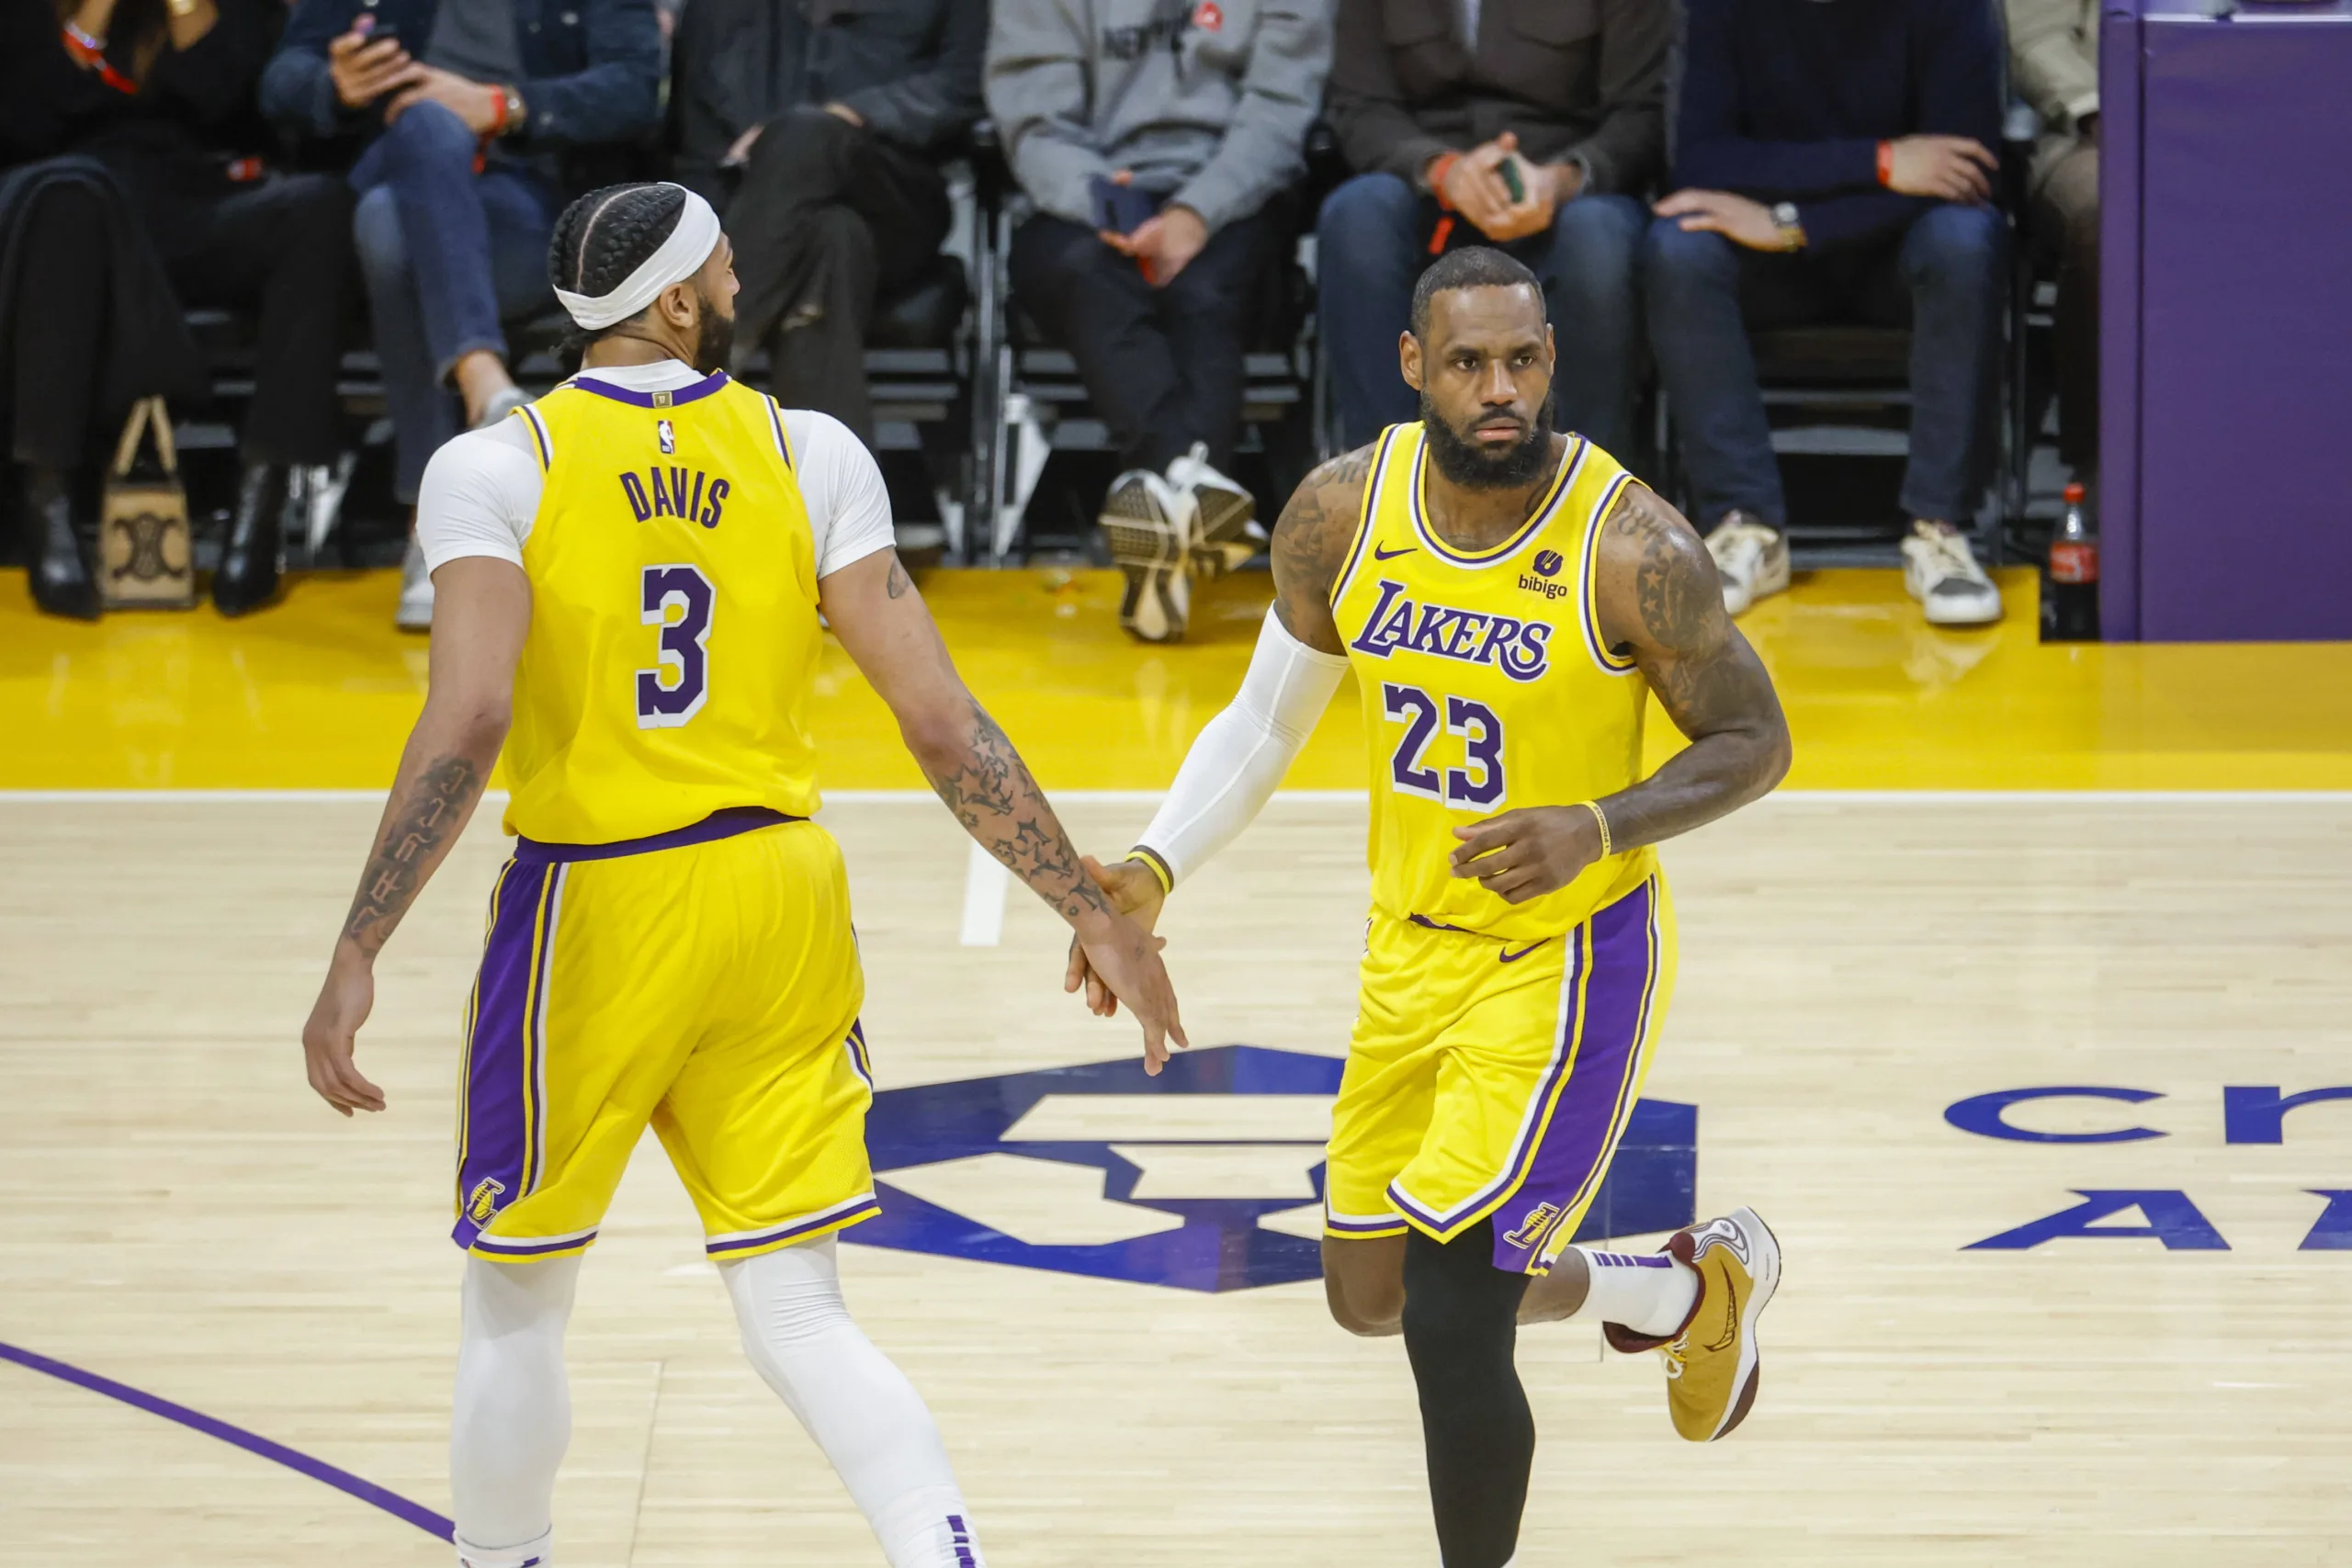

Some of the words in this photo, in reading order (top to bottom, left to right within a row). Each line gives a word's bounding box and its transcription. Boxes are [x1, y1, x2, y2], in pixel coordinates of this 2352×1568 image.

[618, 467, 730, 529] DAVIS
[1518, 574, 1567, 600] bibigo
[635, 563, 717, 730] 3
[1351, 578, 1555, 682] LAKERS
[1380, 681, 1507, 814] 23
[1957, 1190, 2352, 1250] A
